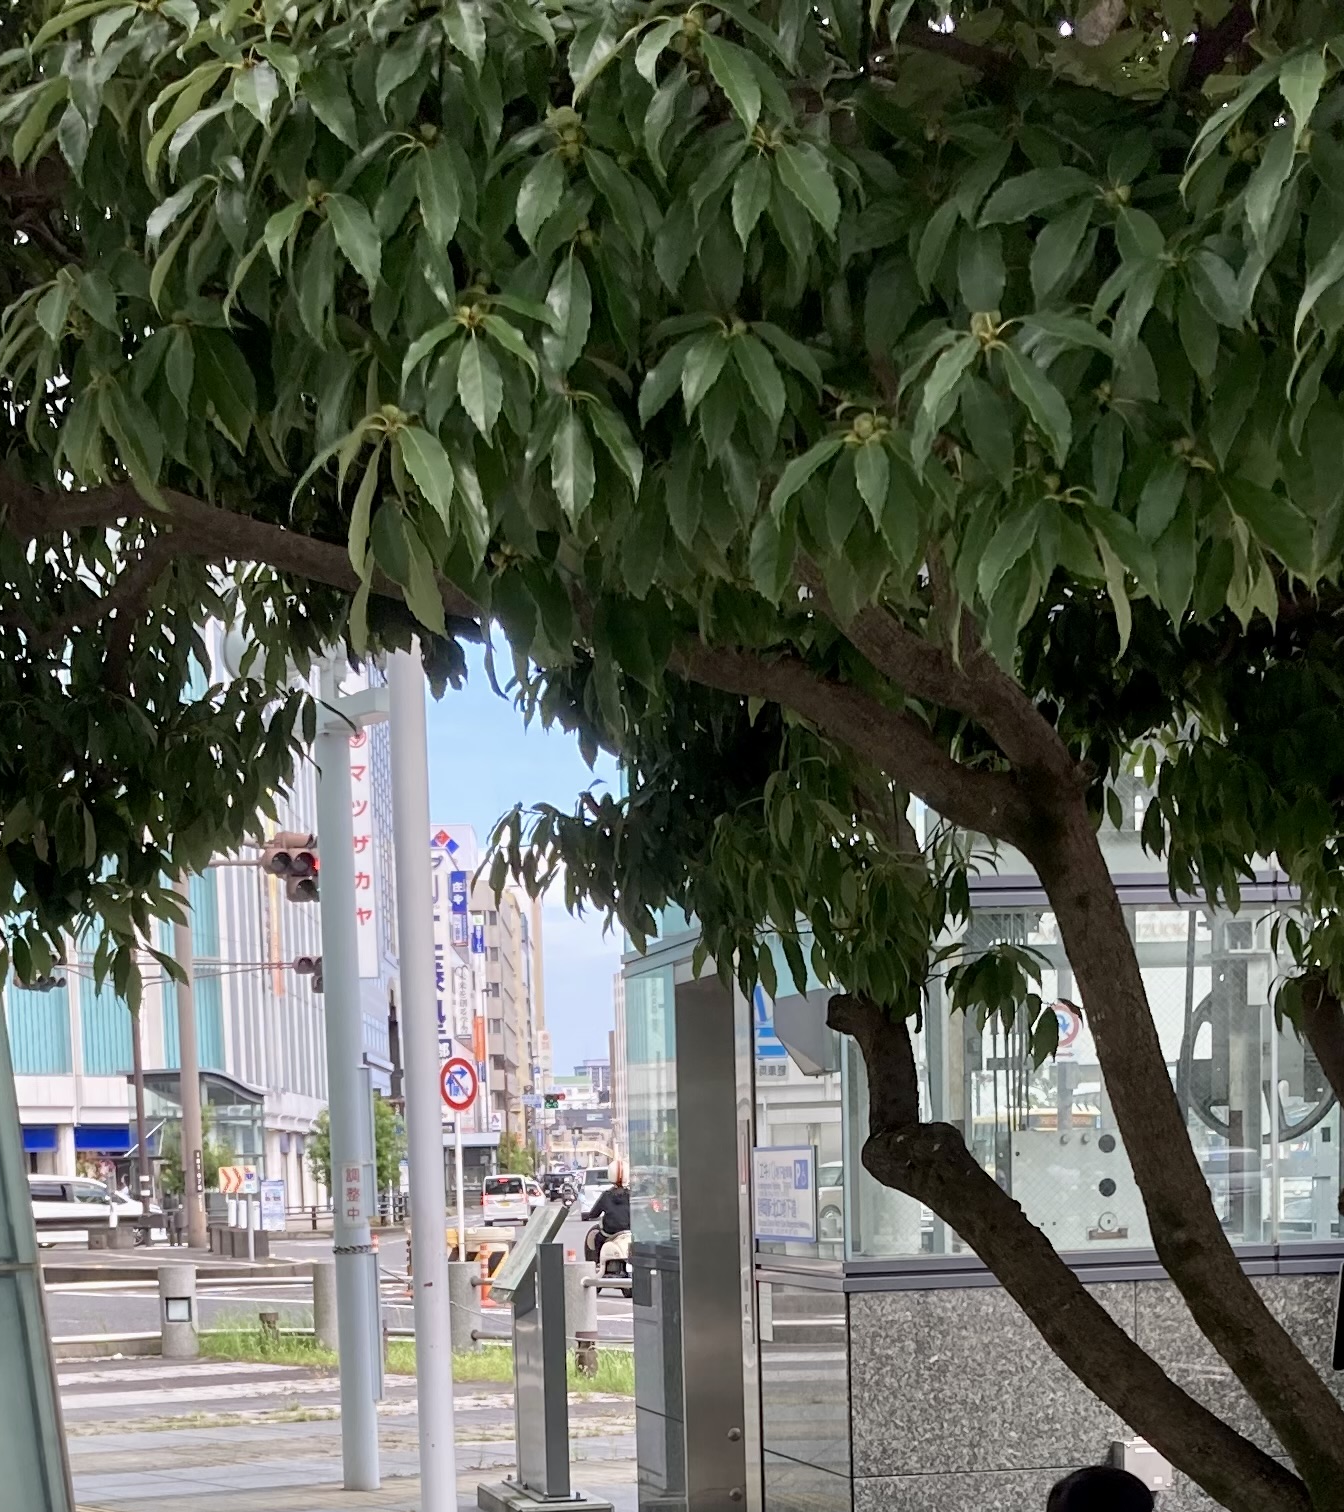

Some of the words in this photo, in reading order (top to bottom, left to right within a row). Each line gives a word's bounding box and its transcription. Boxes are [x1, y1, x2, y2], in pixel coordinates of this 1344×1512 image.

[350, 765, 372, 926] マツザカヤ
[346, 1167, 360, 1221] 調整中
